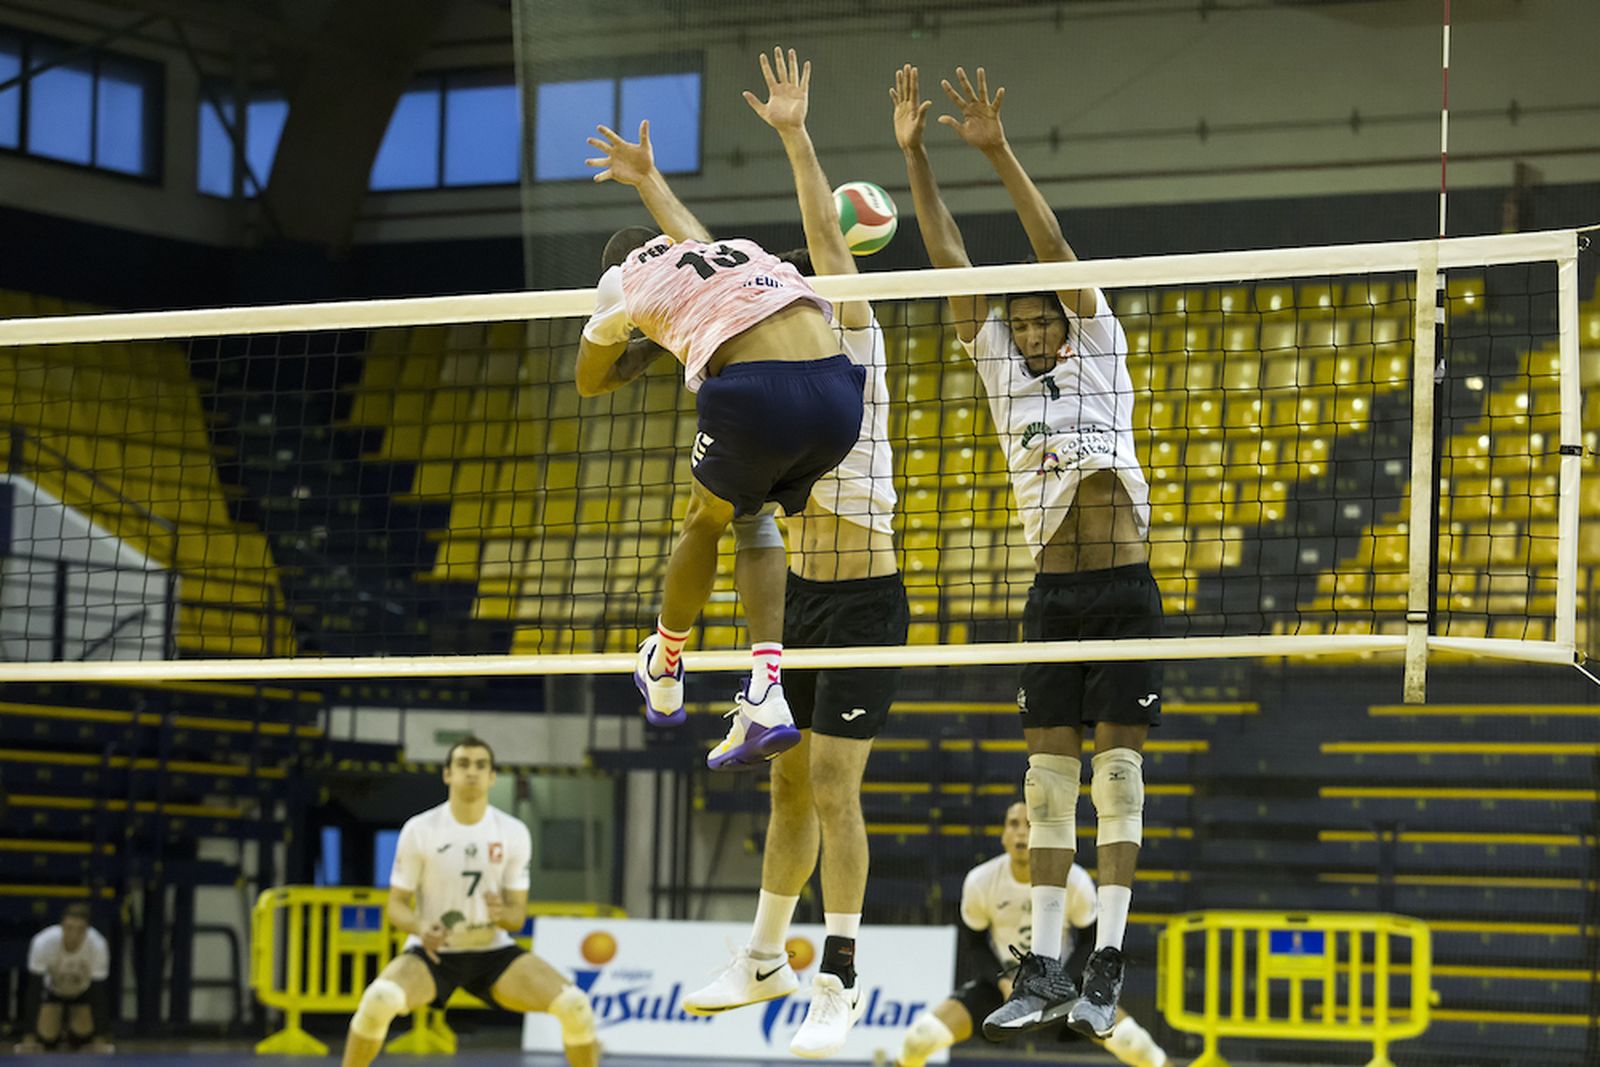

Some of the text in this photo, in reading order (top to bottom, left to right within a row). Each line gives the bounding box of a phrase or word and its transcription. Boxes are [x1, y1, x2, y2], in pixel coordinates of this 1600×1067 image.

[676, 244, 750, 280] 13
[1040, 375, 1060, 401] 1
[461, 871, 483, 897] 7
